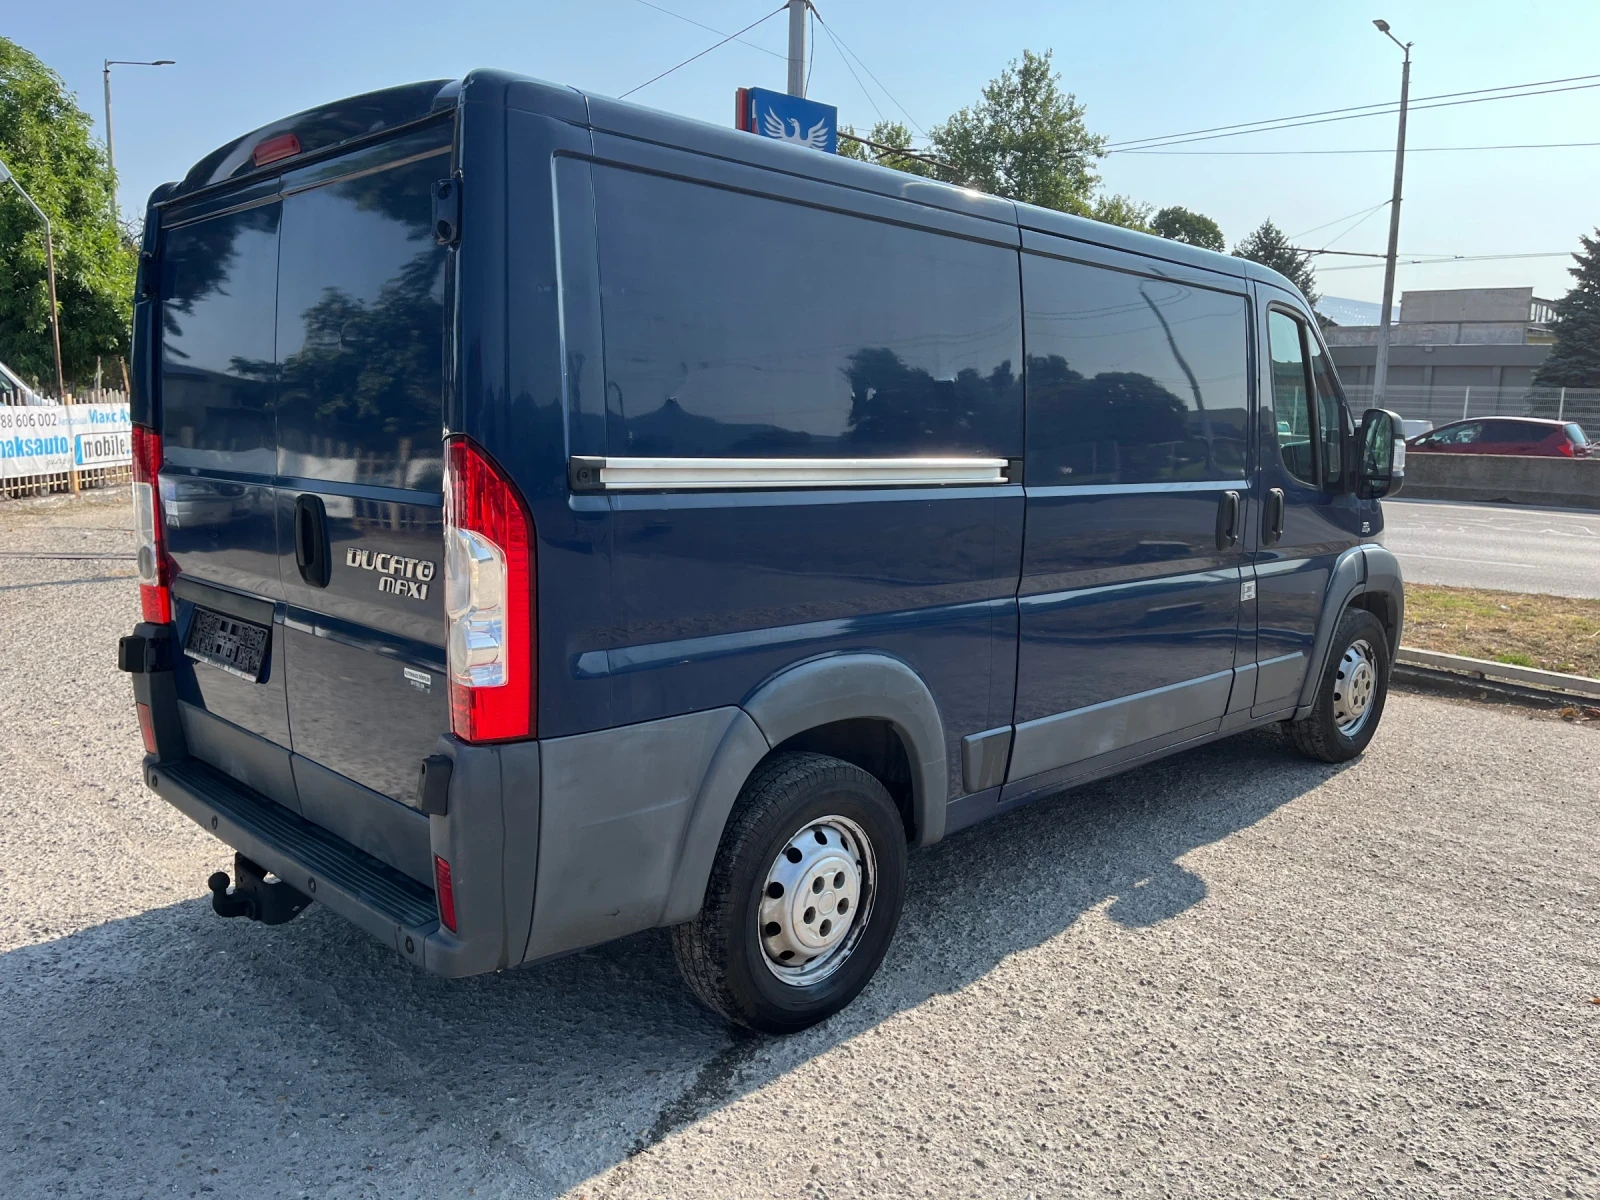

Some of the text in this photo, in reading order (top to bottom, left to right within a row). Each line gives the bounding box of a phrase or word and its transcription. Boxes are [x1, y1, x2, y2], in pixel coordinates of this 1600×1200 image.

[16, 413, 36, 428] 606
[39, 413, 57, 427] 002
[346, 547, 435, 582] DUCATO
[378, 576, 429, 600] MAXI
